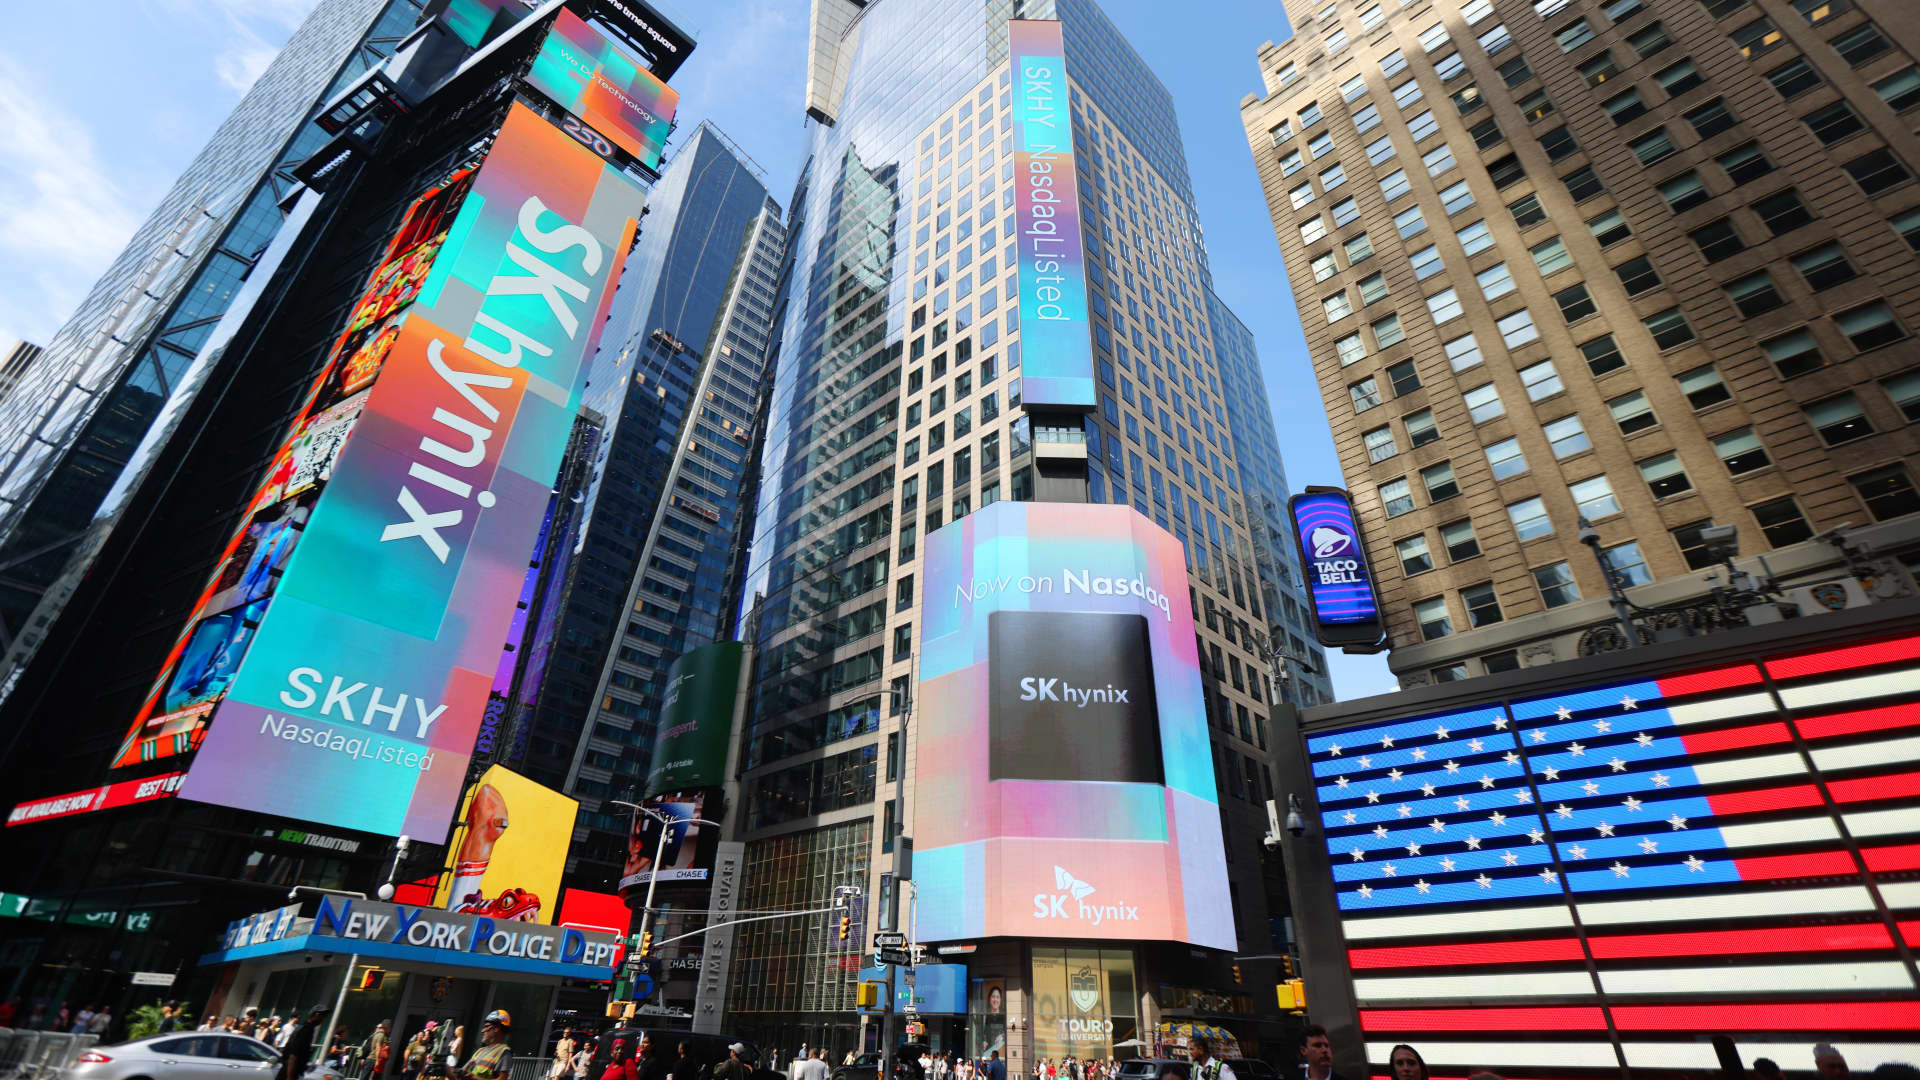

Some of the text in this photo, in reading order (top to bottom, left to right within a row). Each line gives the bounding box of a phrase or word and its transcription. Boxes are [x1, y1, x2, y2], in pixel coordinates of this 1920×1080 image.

[622, 6, 648, 30] times
[647, 26, 678, 54] square
[560, 48, 657, 125] We Do Technology
[561, 115, 614, 157] 250
[1025, 65, 1071, 322] SKHY NasdaqListed
[1313, 559, 1358, 573] TACO
[1320, 571, 1363, 585] BELL
[954, 568, 1173, 622] Now on Nasdaq
[279, 666, 450, 739] SKHY
[1020, 677, 1129, 708] SK hynix
[259, 712, 436, 772] NasdaqListed
[676, 869, 702, 879] CHASE
[311, 894, 621, 967] NEW YORK POLICE DEPT
[705, 937, 724, 993] TIMES
[716, 855, 736, 923] SQUARE
[1033, 893, 1140, 927] SK hynix
[878, 936, 902, 945] ONE WAY
[1058, 1018, 1114, 1033] TOURO
